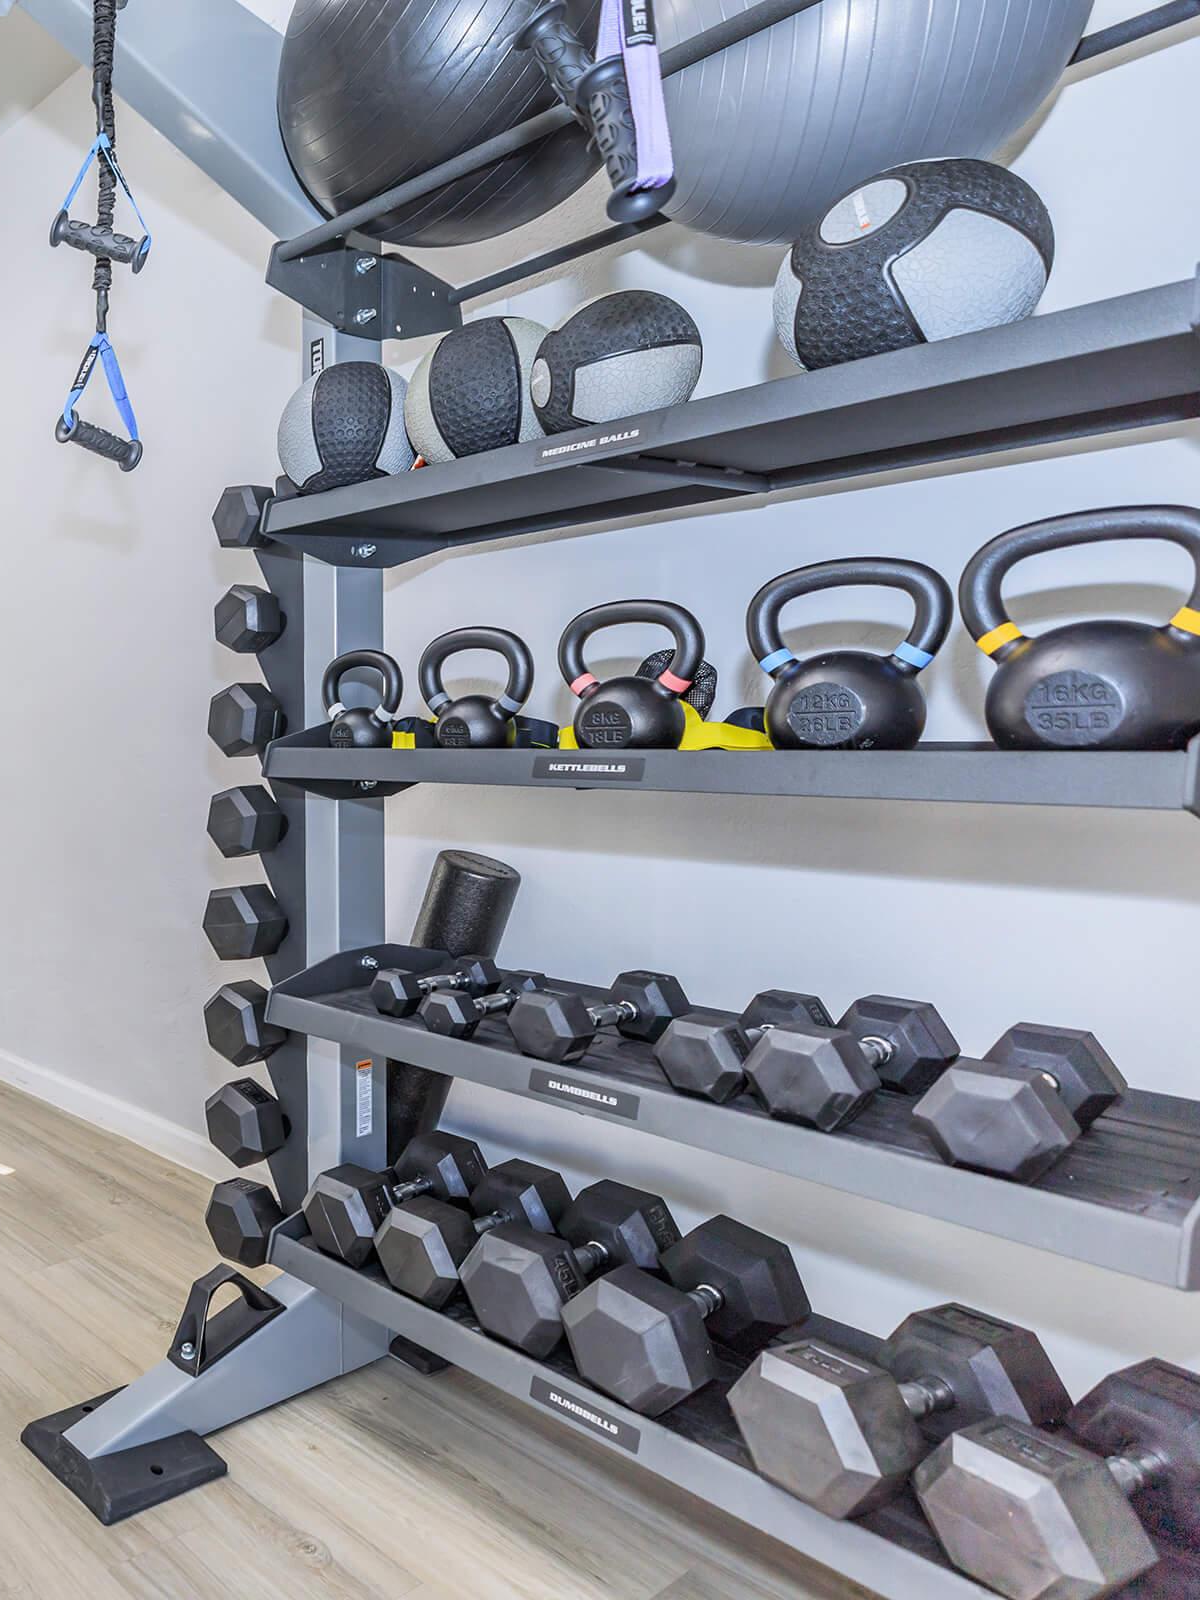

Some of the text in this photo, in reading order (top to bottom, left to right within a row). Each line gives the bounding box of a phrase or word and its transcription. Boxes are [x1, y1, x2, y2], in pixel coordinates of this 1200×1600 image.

[542, 428, 640, 458] MEDICINE BALLS
[799, 692, 851, 710] 12KG
[1038, 682, 1110, 704] 16KG
[1038, 711, 1110, 730] 35LB
[548, 763, 627, 773] KETTLEBELLS
[547, 1080, 618, 1106] DUMBBELLS
[549, 1391, 619, 1435] DUMBBELLS
